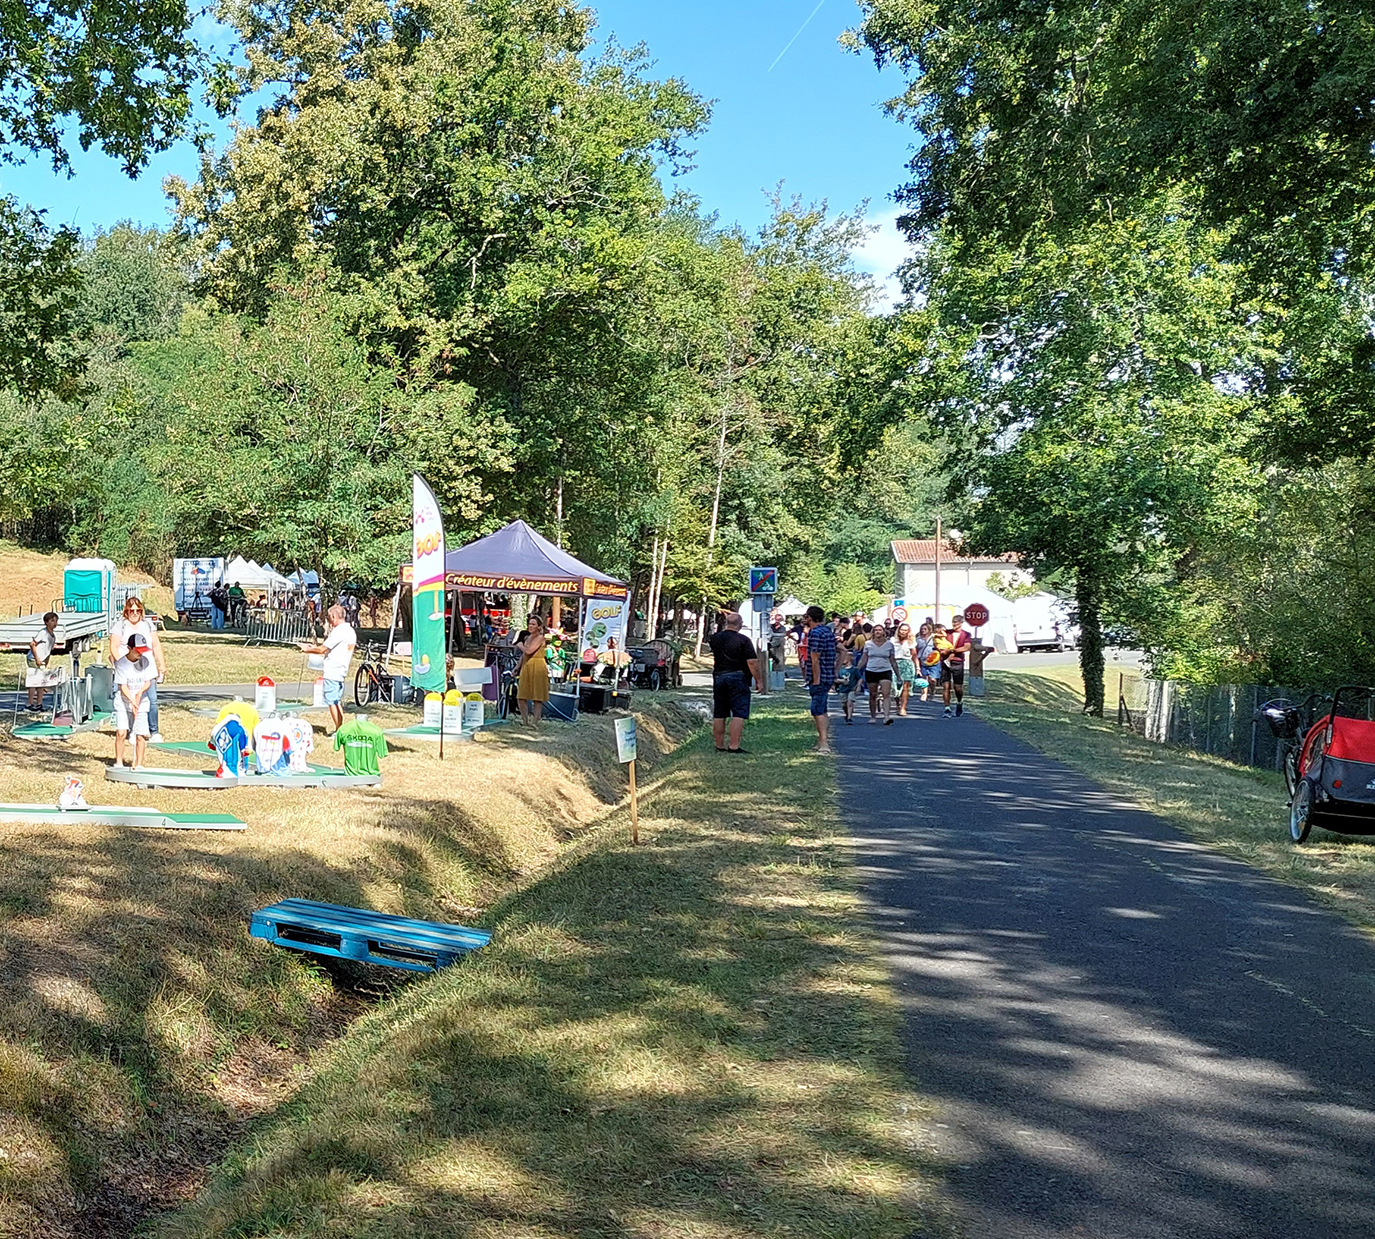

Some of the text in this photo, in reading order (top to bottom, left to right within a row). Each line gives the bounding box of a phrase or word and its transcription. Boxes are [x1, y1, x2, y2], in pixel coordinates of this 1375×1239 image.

[445, 573, 496, 588] Créateur
[496, 576, 579, 593] d'évènements
[592, 605, 622, 621] GOLF
[966, 611, 988, 620] STOP
